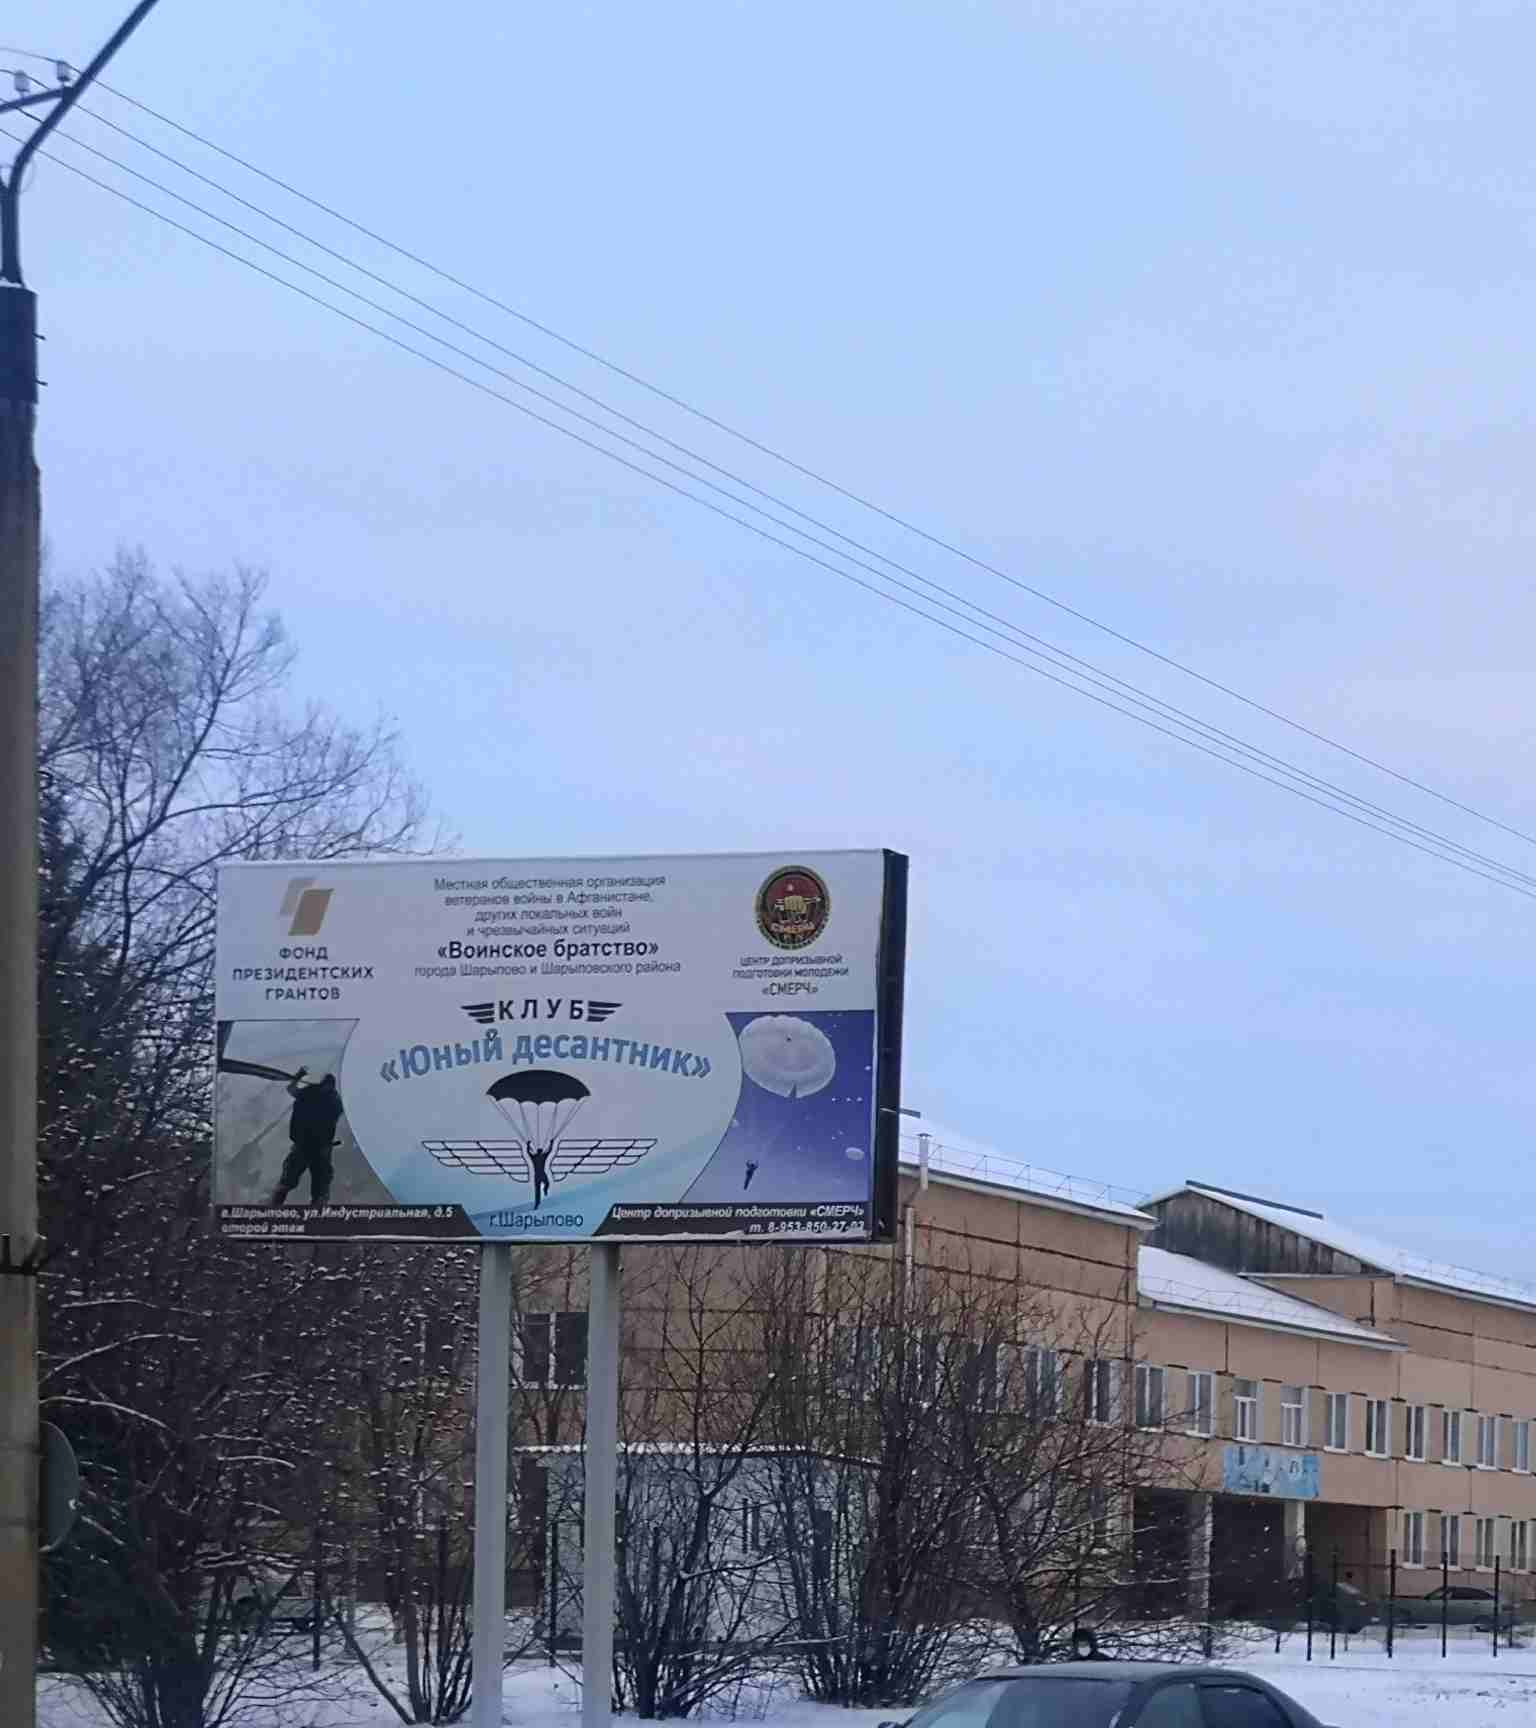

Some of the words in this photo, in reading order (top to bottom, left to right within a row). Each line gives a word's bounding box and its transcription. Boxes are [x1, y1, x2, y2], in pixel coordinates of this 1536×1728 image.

[434, 877, 488, 891] Местная
[491, 876, 583, 890] общественная
[586, 875, 666, 890] организация
[474, 909, 517, 923] других
[520, 907, 588, 920] локальных
[592, 905, 622, 919] войн
[467, 927, 474, 936] и
[572, 920, 630, 935] ситуаций
[279, 946, 328, 960] ФОНД
[437, 941, 547, 960] «Воинское
[553, 938, 659, 960] братство»
[232, 966, 375, 981] ПРЕЗИДЕНТСКИХ
[414, 965, 456, 978] города
[460, 963, 527, 978] Шарыпово
[530, 965, 537, 975] и
[541, 962, 632, 977] Шарыповского
[635, 960, 681, 975] района
[265, 987, 341, 1001] ГРАНТОВ
[762, 981, 818, 996] «СМЕРЧ»
[498, 999, 585, 1020] КЛУБ
[379, 1027, 503, 1083] «Юный
[512, 1033, 712, 1079] десантник»
[611, 1206, 651, 1220] Центр
[653, 1205, 733, 1219] допризывной
[734, 1205, 807, 1219] подготовки
